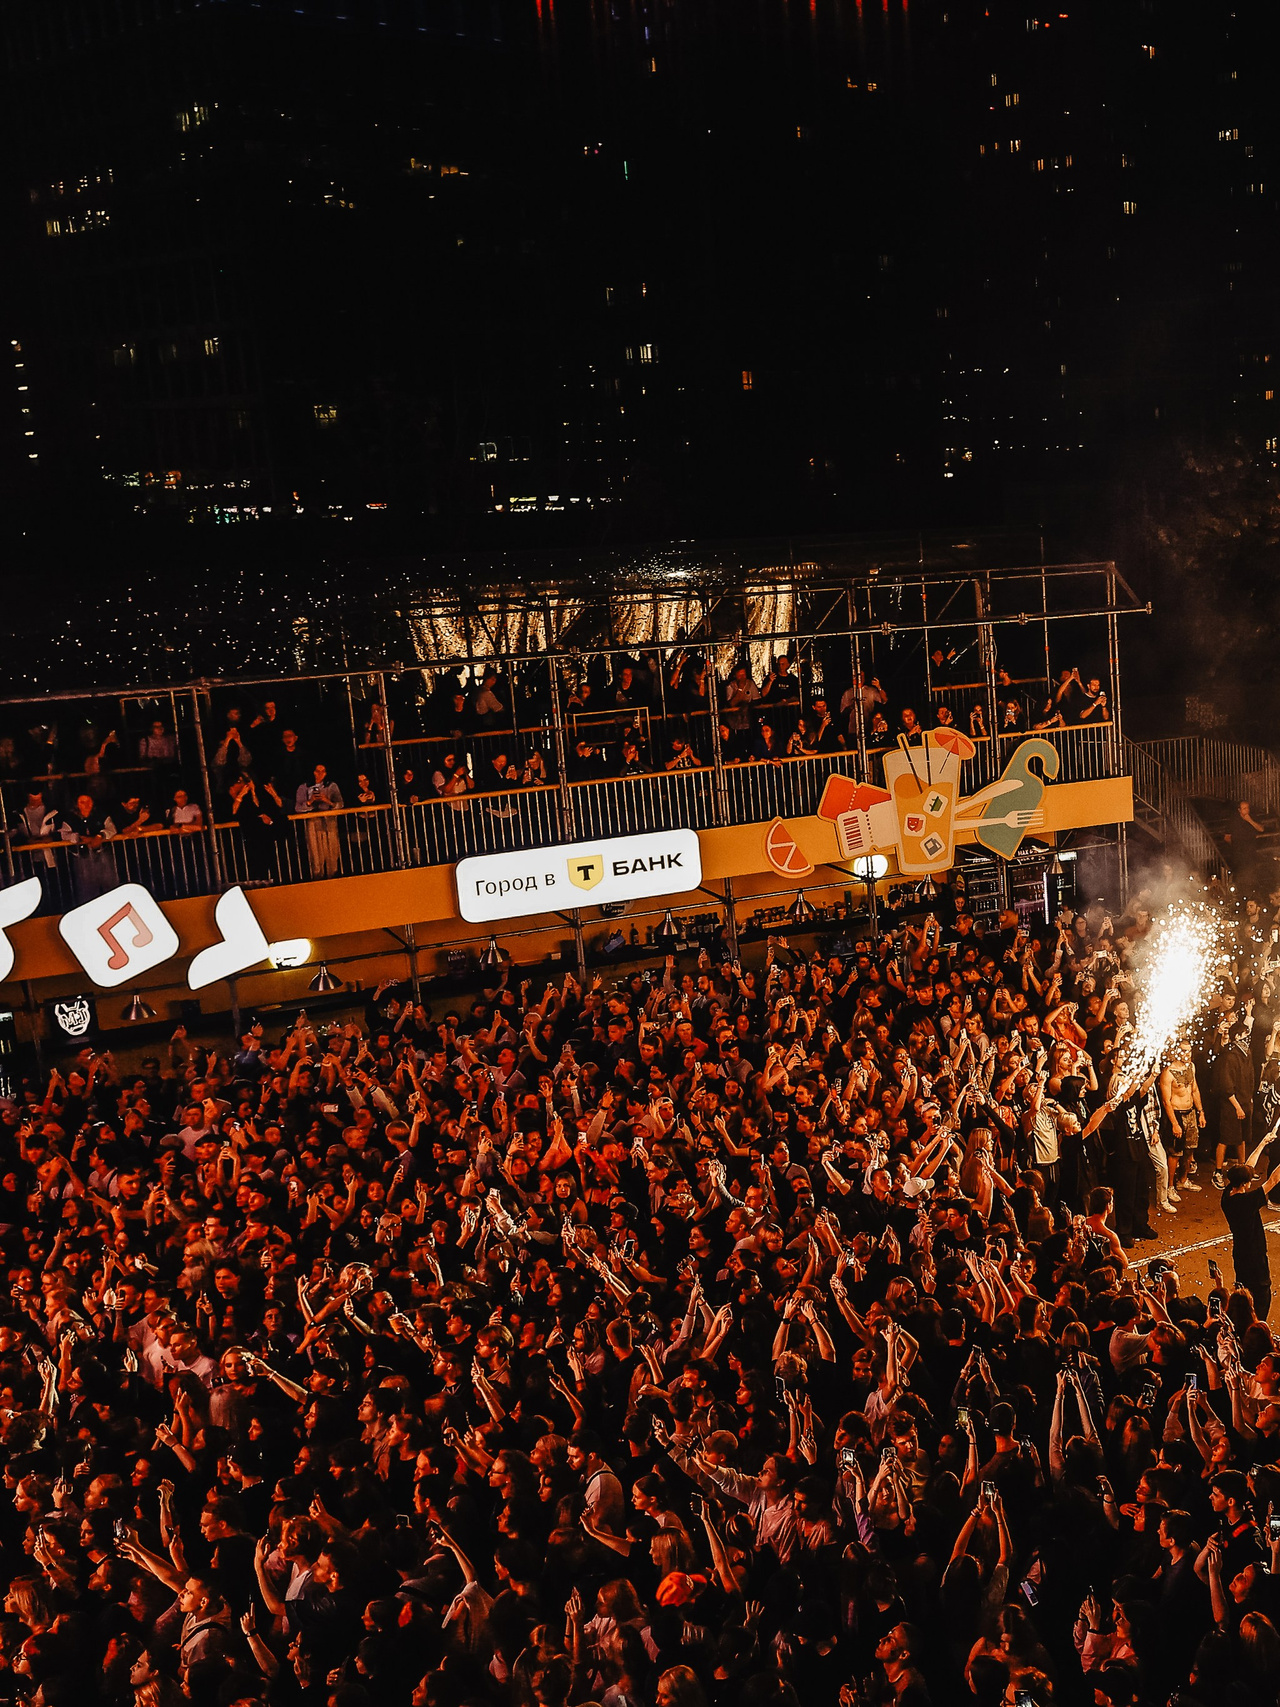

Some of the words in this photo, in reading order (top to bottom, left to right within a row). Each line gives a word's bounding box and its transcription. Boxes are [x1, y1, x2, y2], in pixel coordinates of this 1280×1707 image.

[475, 875, 538, 896] Город
[545, 873, 556, 886] в
[612, 852, 683, 876] БАНК
